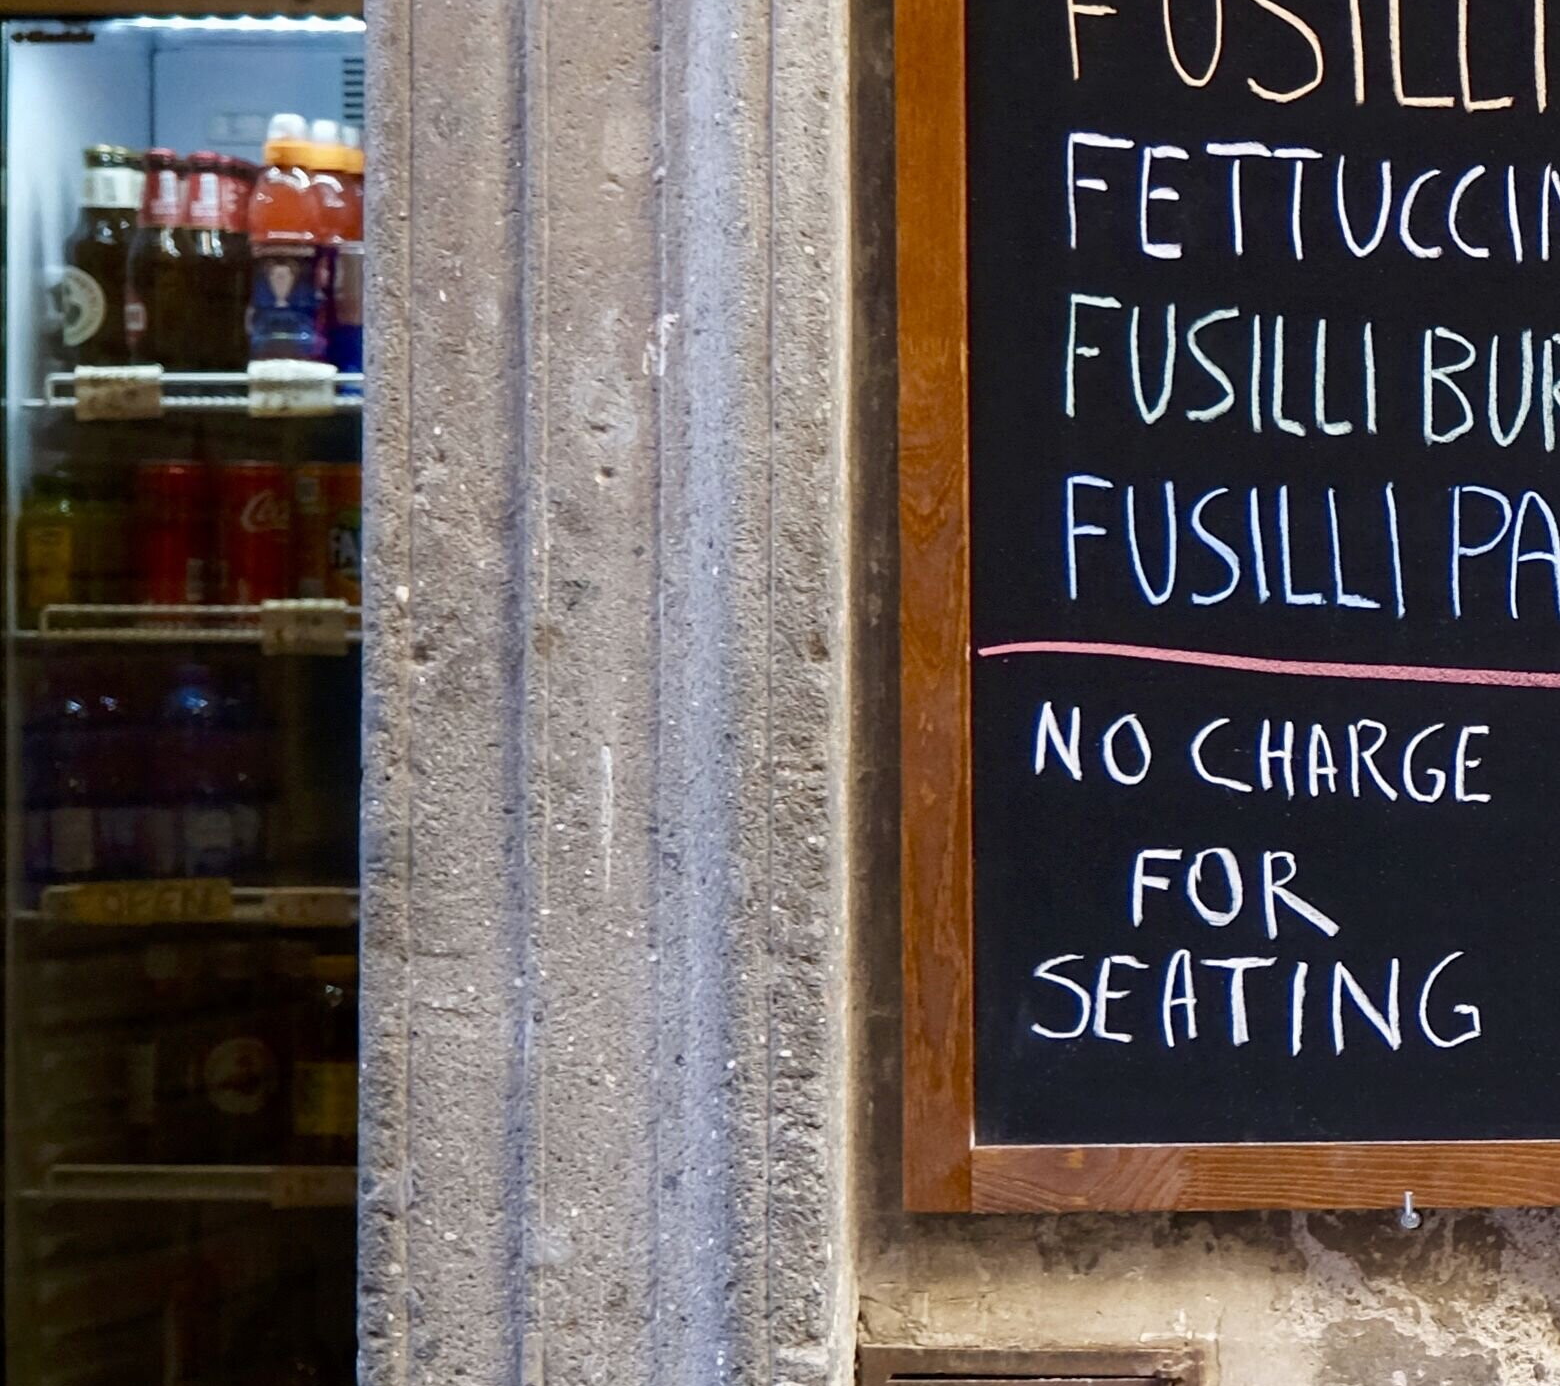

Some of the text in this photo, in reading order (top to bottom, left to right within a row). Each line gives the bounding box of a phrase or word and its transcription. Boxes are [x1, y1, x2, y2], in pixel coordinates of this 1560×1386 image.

[1065, 293, 1376, 436] FUSILLI
[1066, 474, 1405, 618] FUSILLI
[1034, 701, 1491, 802] NO CHARGE
[1132, 848, 1339, 939] FOR
[1031, 949, 1481, 1056] SEATING
